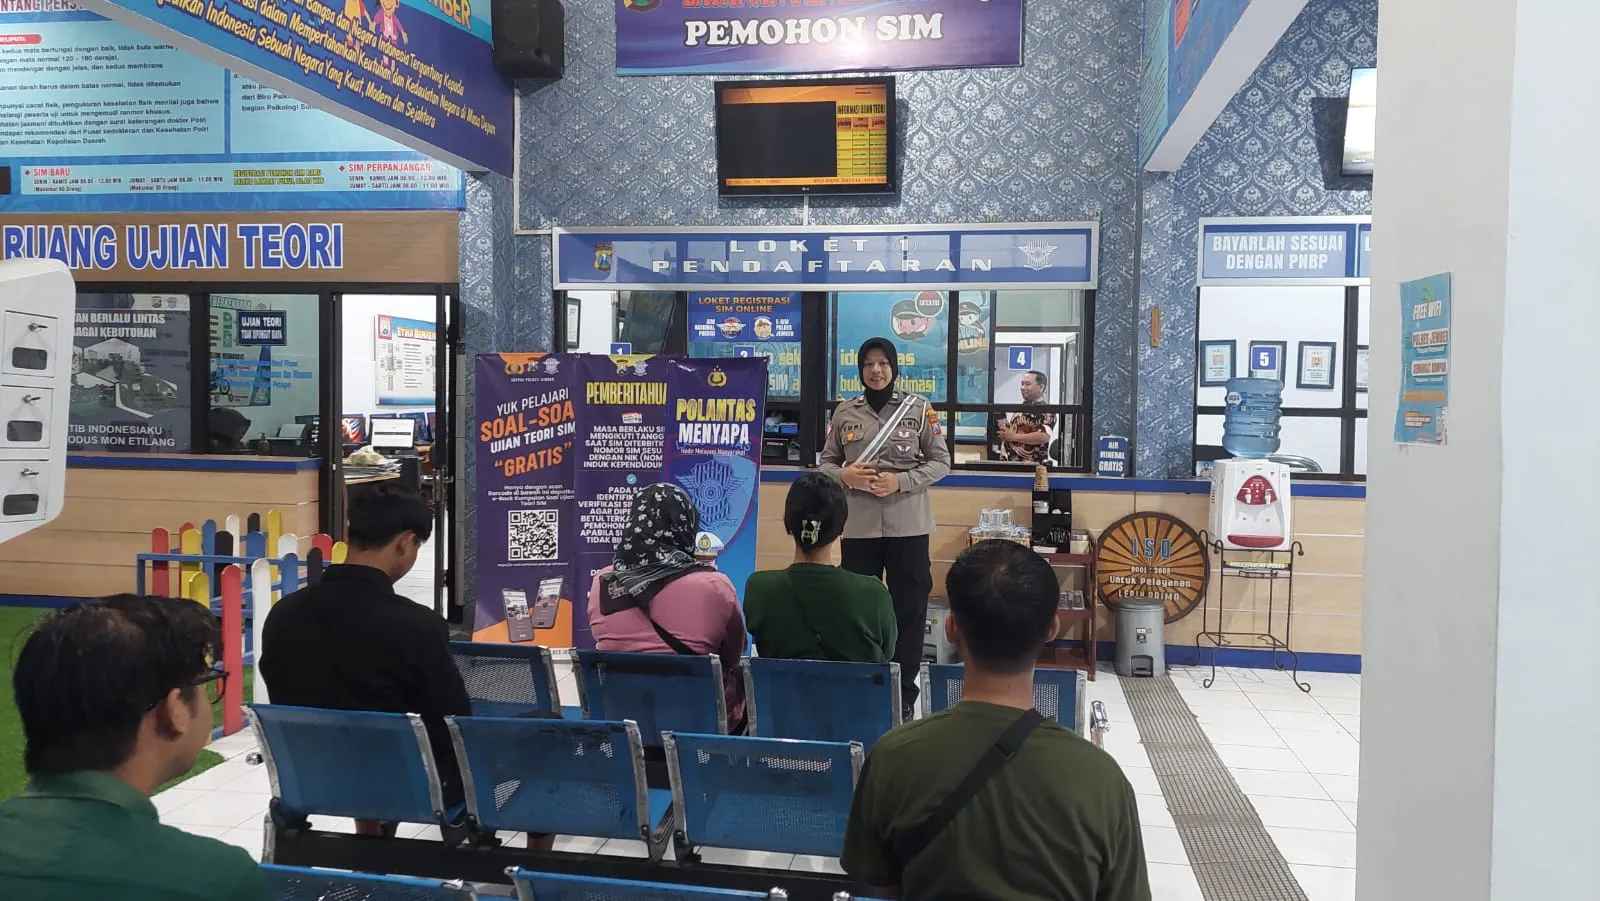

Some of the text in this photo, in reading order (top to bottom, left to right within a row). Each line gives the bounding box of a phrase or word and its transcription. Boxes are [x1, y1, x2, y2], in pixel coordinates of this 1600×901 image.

[684, 12, 944, 46] PEMOHON SIM
[336, 10, 350, 30] dan
[351, 19, 377, 48] Negara
[378, 34, 410, 66] Indonesia
[410, 53, 443, 89] Tergantung
[443, 72, 465, 97] Kepada
[205, 1, 257, 43] Indonesia
[257, 28, 293, 59] Sebuah
[294, 44, 325, 74] Negara
[325, 60, 344, 90] Yang
[344, 69, 365, 98] Kuat,
[365, 81, 391, 108] Modern
[392, 93, 405, 113] dan
[406, 101, 436, 129] Sejahtera
[260, 1, 288, 27] dalam
[290, 12, 357, 61] Mempertahankan
[359, 49, 391, 80] Keutuhan
[392, 67, 405, 88] dan
[406, 75, 439, 106] Kedaulatan
[440, 94, 461, 117] Negara
[460, 103, 467, 121] di
[467, 108, 481, 128] Masa
[481, 115, 496, 136] Depan
[33, 168, 71, 176] SIM BARU
[349, 163, 431, 172] SIM PERPANJANGAN
[4, 223, 343, 270] RUANG UJIAN TEORI
[730, 239, 909, 252] LOKET 1
[1212, 234, 1343, 250] BAYARLAH SESUAI
[652, 259, 992, 273] PENDAFTARAN
[1225, 253, 1328, 270] DENGAN PNBP
[716, 305, 773, 313] SIM ONLINE
[1412, 300, 1442, 320] FREE WIFI
[90, 313, 165, 324] BERLALU LINTAS
[241, 317, 282, 327] UJIAN TEORI
[100, 327, 157, 338] KEBUTUHAN
[1016, 351, 1026, 366] 4
[1260, 352, 1270, 367] 5
[769, 374, 788, 391] SIM
[497, 387, 569, 416] YUK PELAJARI
[676, 398, 756, 422] POLANTAS
[88, 425, 162, 435] INDONESIAKU
[679, 423, 749, 445] MENYAPA
[100, 437, 126, 445] MON
[129, 437, 175, 447] ETILANG
[490, 436, 521, 453] UJIAN
[524, 427, 554, 445] TEORI
[1108, 441, 1118, 449] AIR
[695, 448, 717, 456] Melayani
[1100, 450, 1125, 459] MINERAL
[1099, 461, 1124, 472] GRATIS
[1132, 538, 1171, 559] ISO
[1109, 575, 1191, 588] Untuk Pelayanan
[1148, 590, 1181, 601] PRIMA
